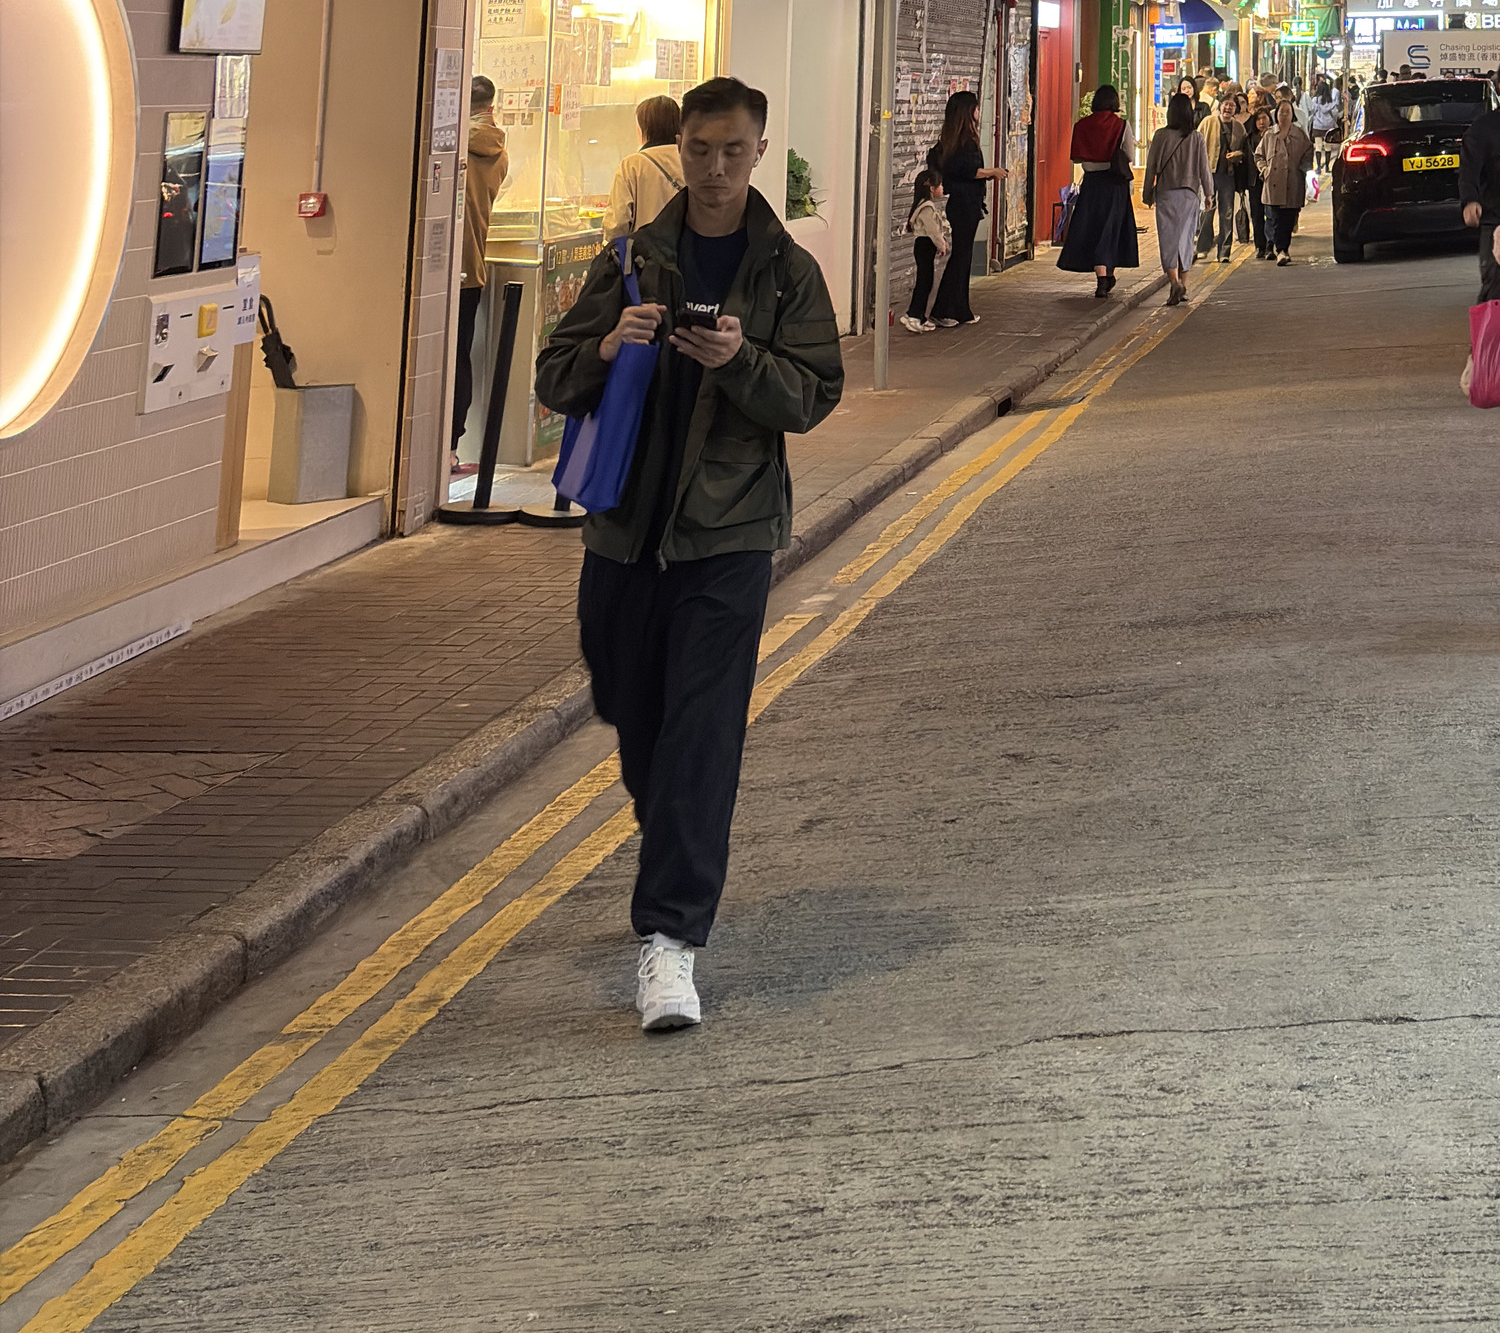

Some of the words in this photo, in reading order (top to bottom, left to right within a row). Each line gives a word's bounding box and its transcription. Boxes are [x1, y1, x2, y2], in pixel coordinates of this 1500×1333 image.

[1439, 43, 1471, 53] Chasing
[1408, 159, 1424, 170] YJ
[1425, 157, 1455, 168] 5628
